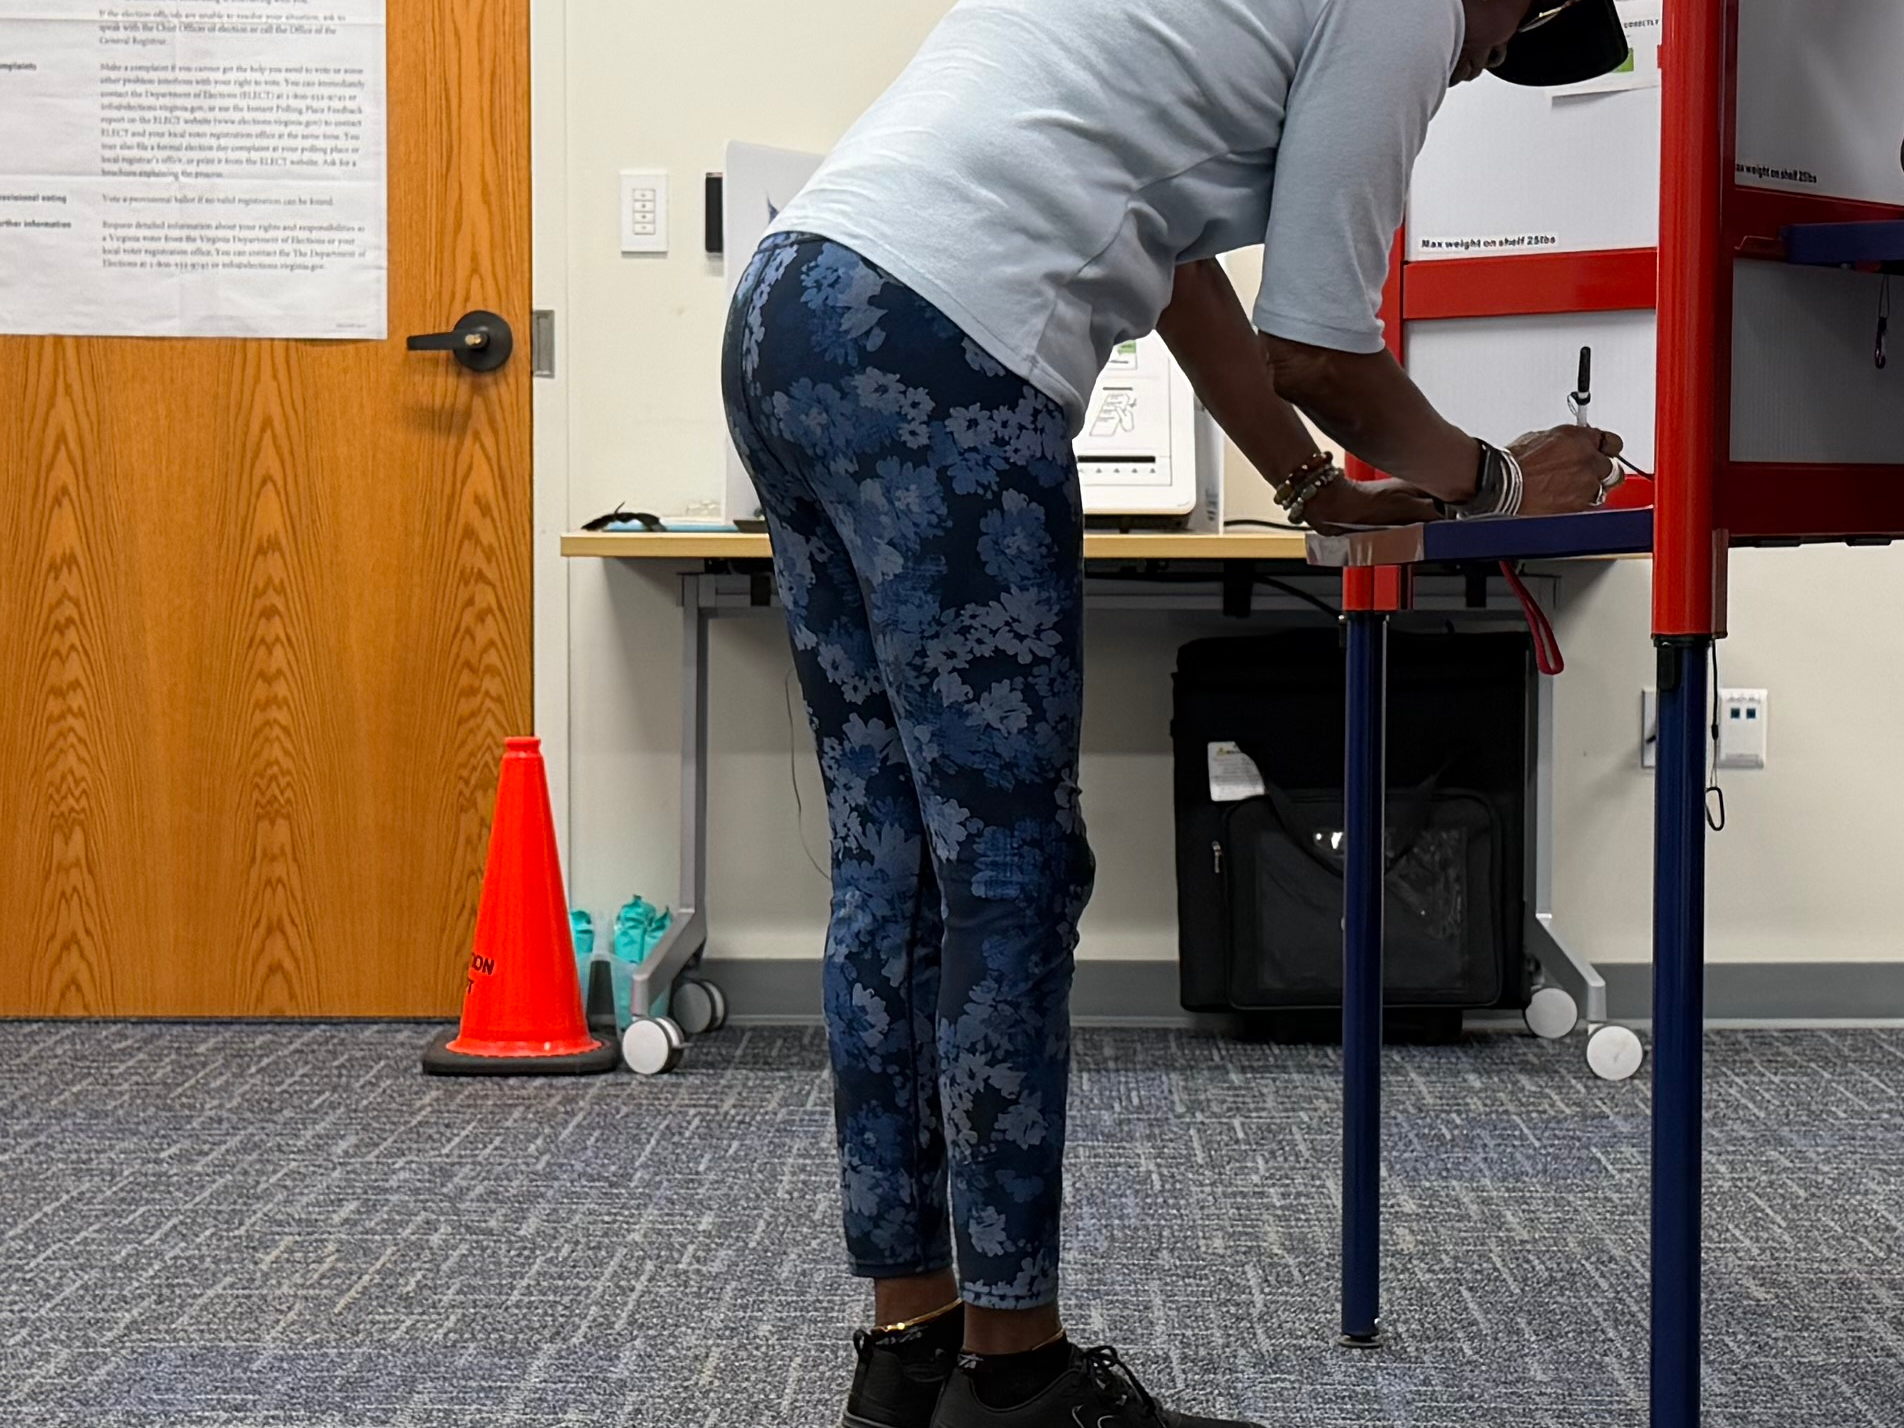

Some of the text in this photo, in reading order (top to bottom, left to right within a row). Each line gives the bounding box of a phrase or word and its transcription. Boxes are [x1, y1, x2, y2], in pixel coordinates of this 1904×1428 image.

[1422, 240, 1442, 248] Max
[1445, 239, 1480, 250] weight
[1499, 237, 1524, 246] shelf
